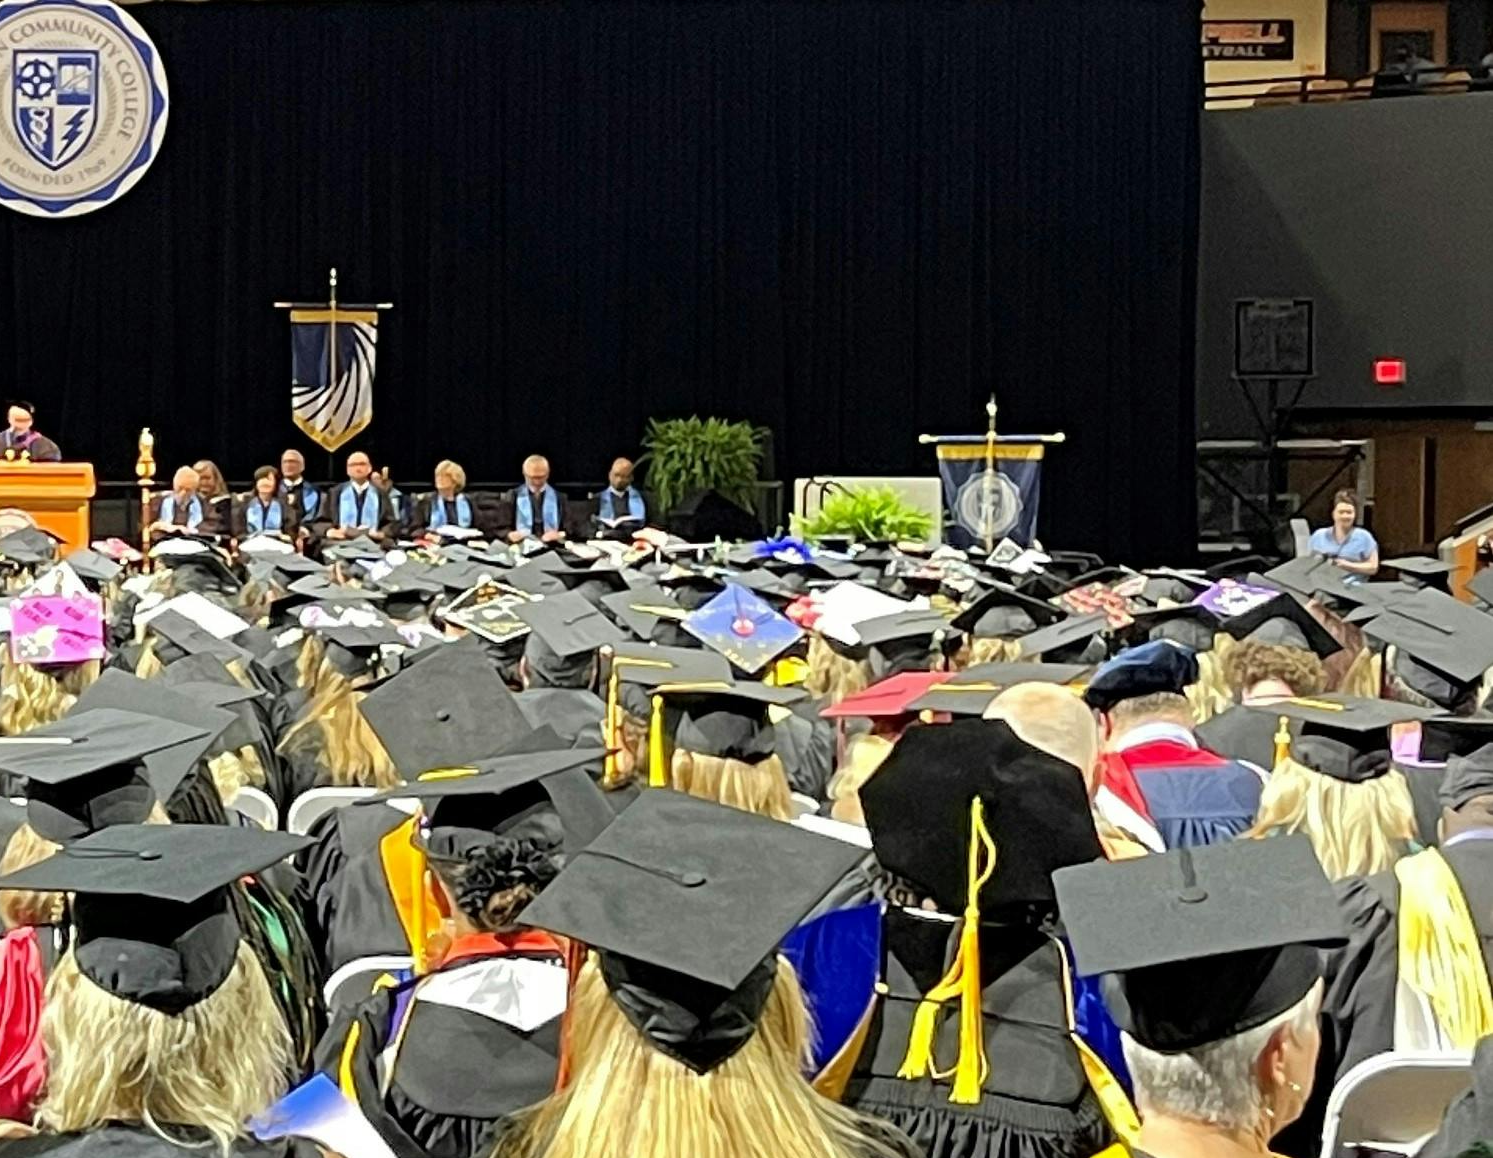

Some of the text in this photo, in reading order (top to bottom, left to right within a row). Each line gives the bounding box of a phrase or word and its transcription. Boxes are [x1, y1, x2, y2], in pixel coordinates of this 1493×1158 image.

[9, 18, 121, 58] COMMUNITY
[116, 58, 139, 140] COLLEGE
[2, 157, 74, 186] FOUNDED
